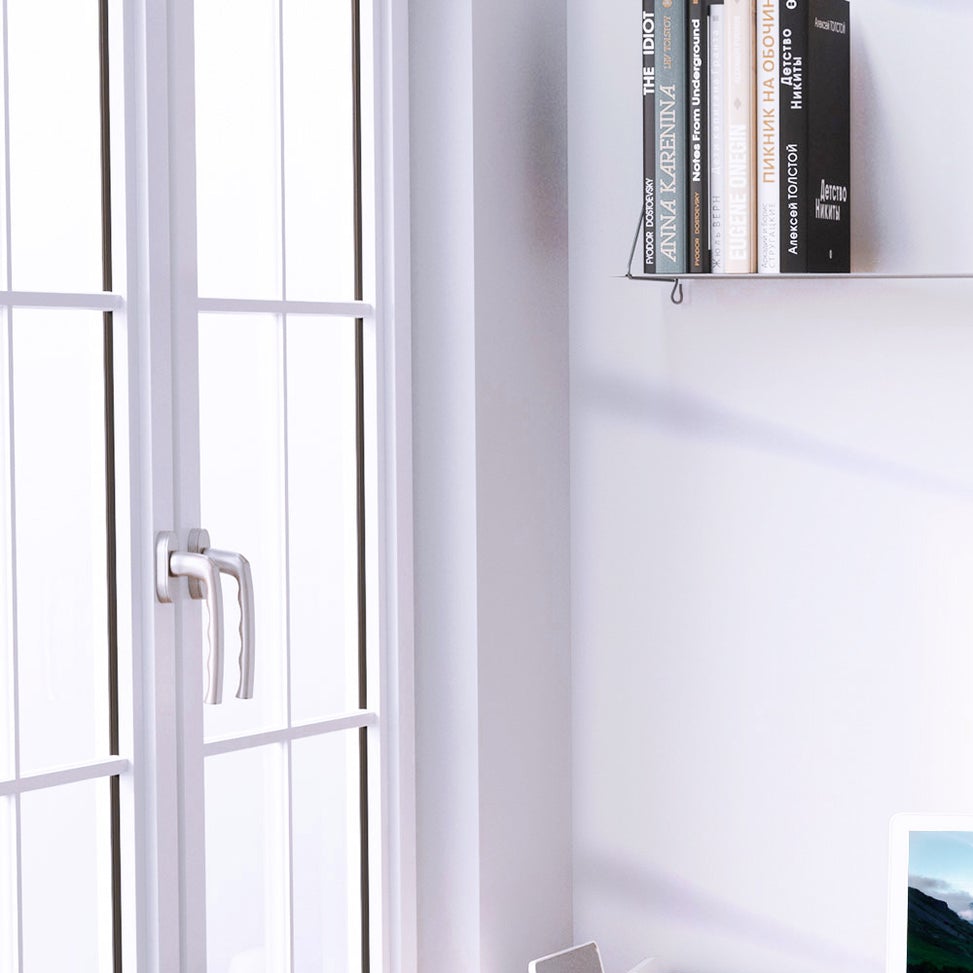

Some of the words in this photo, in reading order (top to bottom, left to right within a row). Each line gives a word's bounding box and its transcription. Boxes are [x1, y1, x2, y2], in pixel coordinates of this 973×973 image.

[643, 11, 656, 55] IDIOT
[781, 28, 792, 87] Детство
[643, 66, 655, 96] THE
[692, 19, 702, 104] Underground
[790, 56, 802, 110] Никиты
[763, 77, 775, 102] НА
[659, 84, 676, 194] KARENINA
[692, 108, 700, 148] From
[763, 108, 775, 183] ПИКНИК
[692, 151, 700, 182] Notes
[728, 124, 747, 188] ONEGIN
[785, 143, 798, 200] ТОЛСТОЙ
[645, 178, 654, 228] DOSTOEVSKY
[712, 195, 720, 228] ВЕРН
[815, 198, 841, 221] Никиты
[820, 179, 847, 202] Детство
[645, 232, 654, 265] FYODOR
[659, 199, 677, 262] ANNA
[712, 231, 721, 269] Жюль
[728, 193, 747, 260] EUGENE
[788, 202, 798, 255] Алексей
